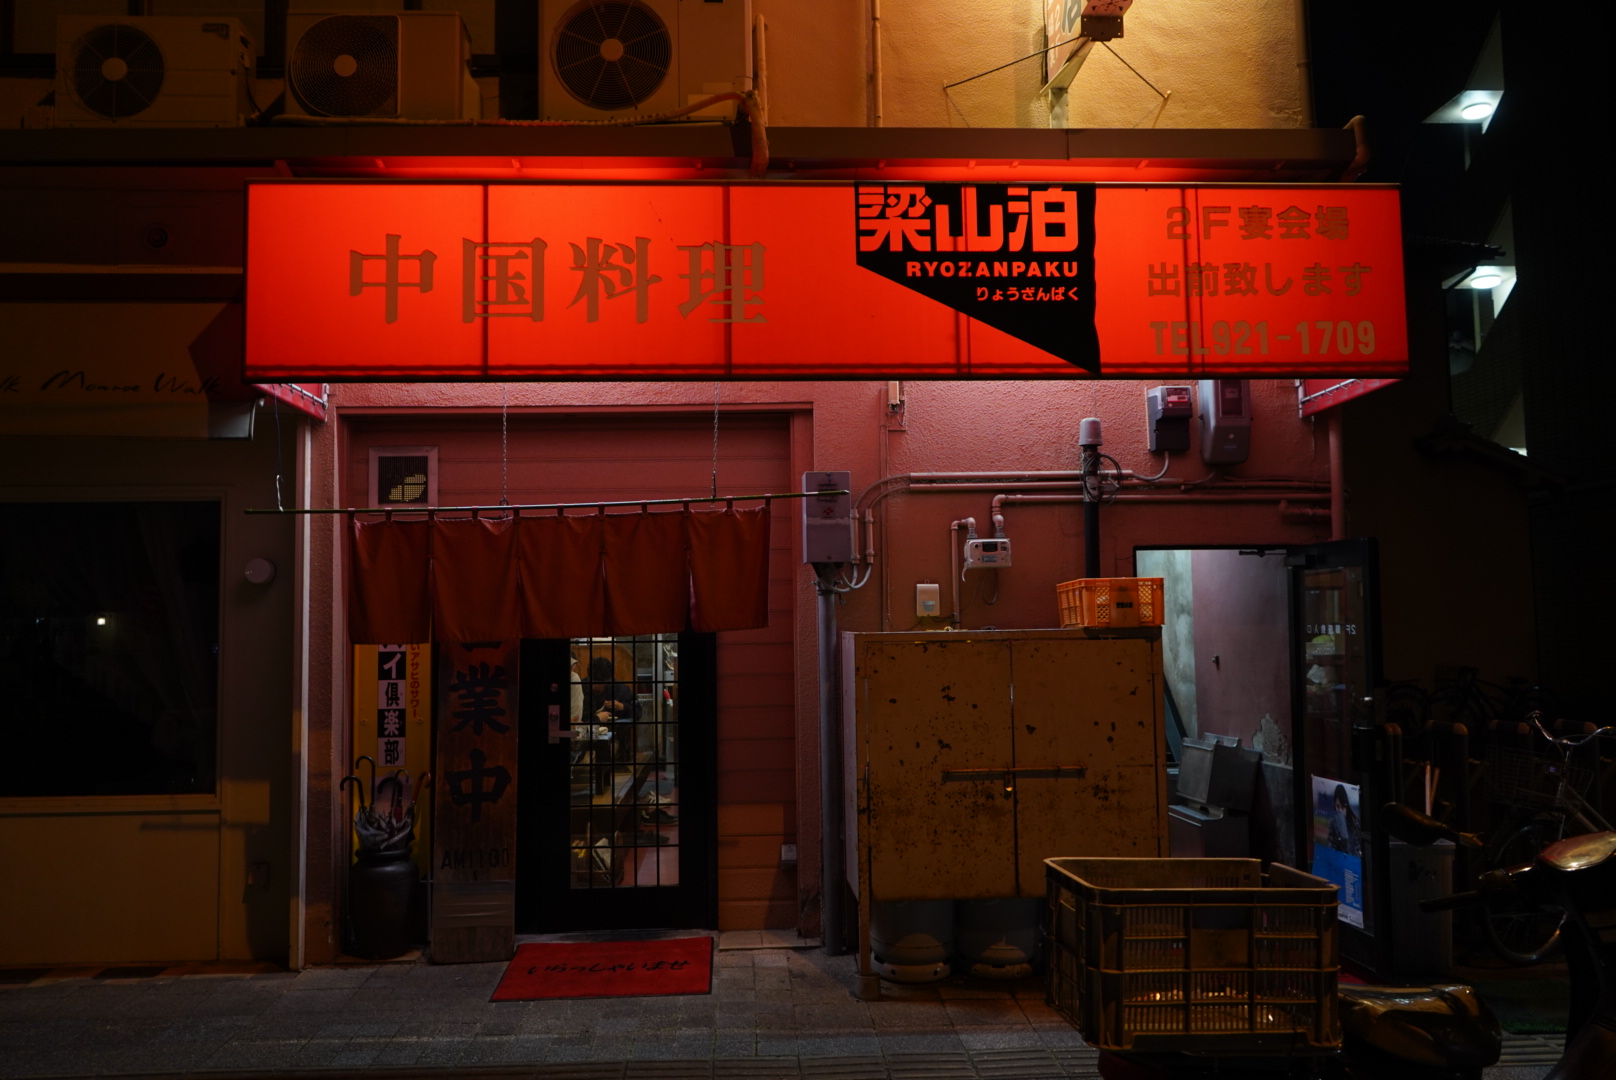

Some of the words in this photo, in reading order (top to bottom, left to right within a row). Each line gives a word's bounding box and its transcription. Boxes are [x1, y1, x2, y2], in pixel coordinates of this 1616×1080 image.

[858, 186, 1079, 252] 梁山泊
[349, 233, 768, 325] 中国料理
[906, 261, 1079, 278] RYOZANPAKU
[1147, 262, 1372, 298] 出前致します
